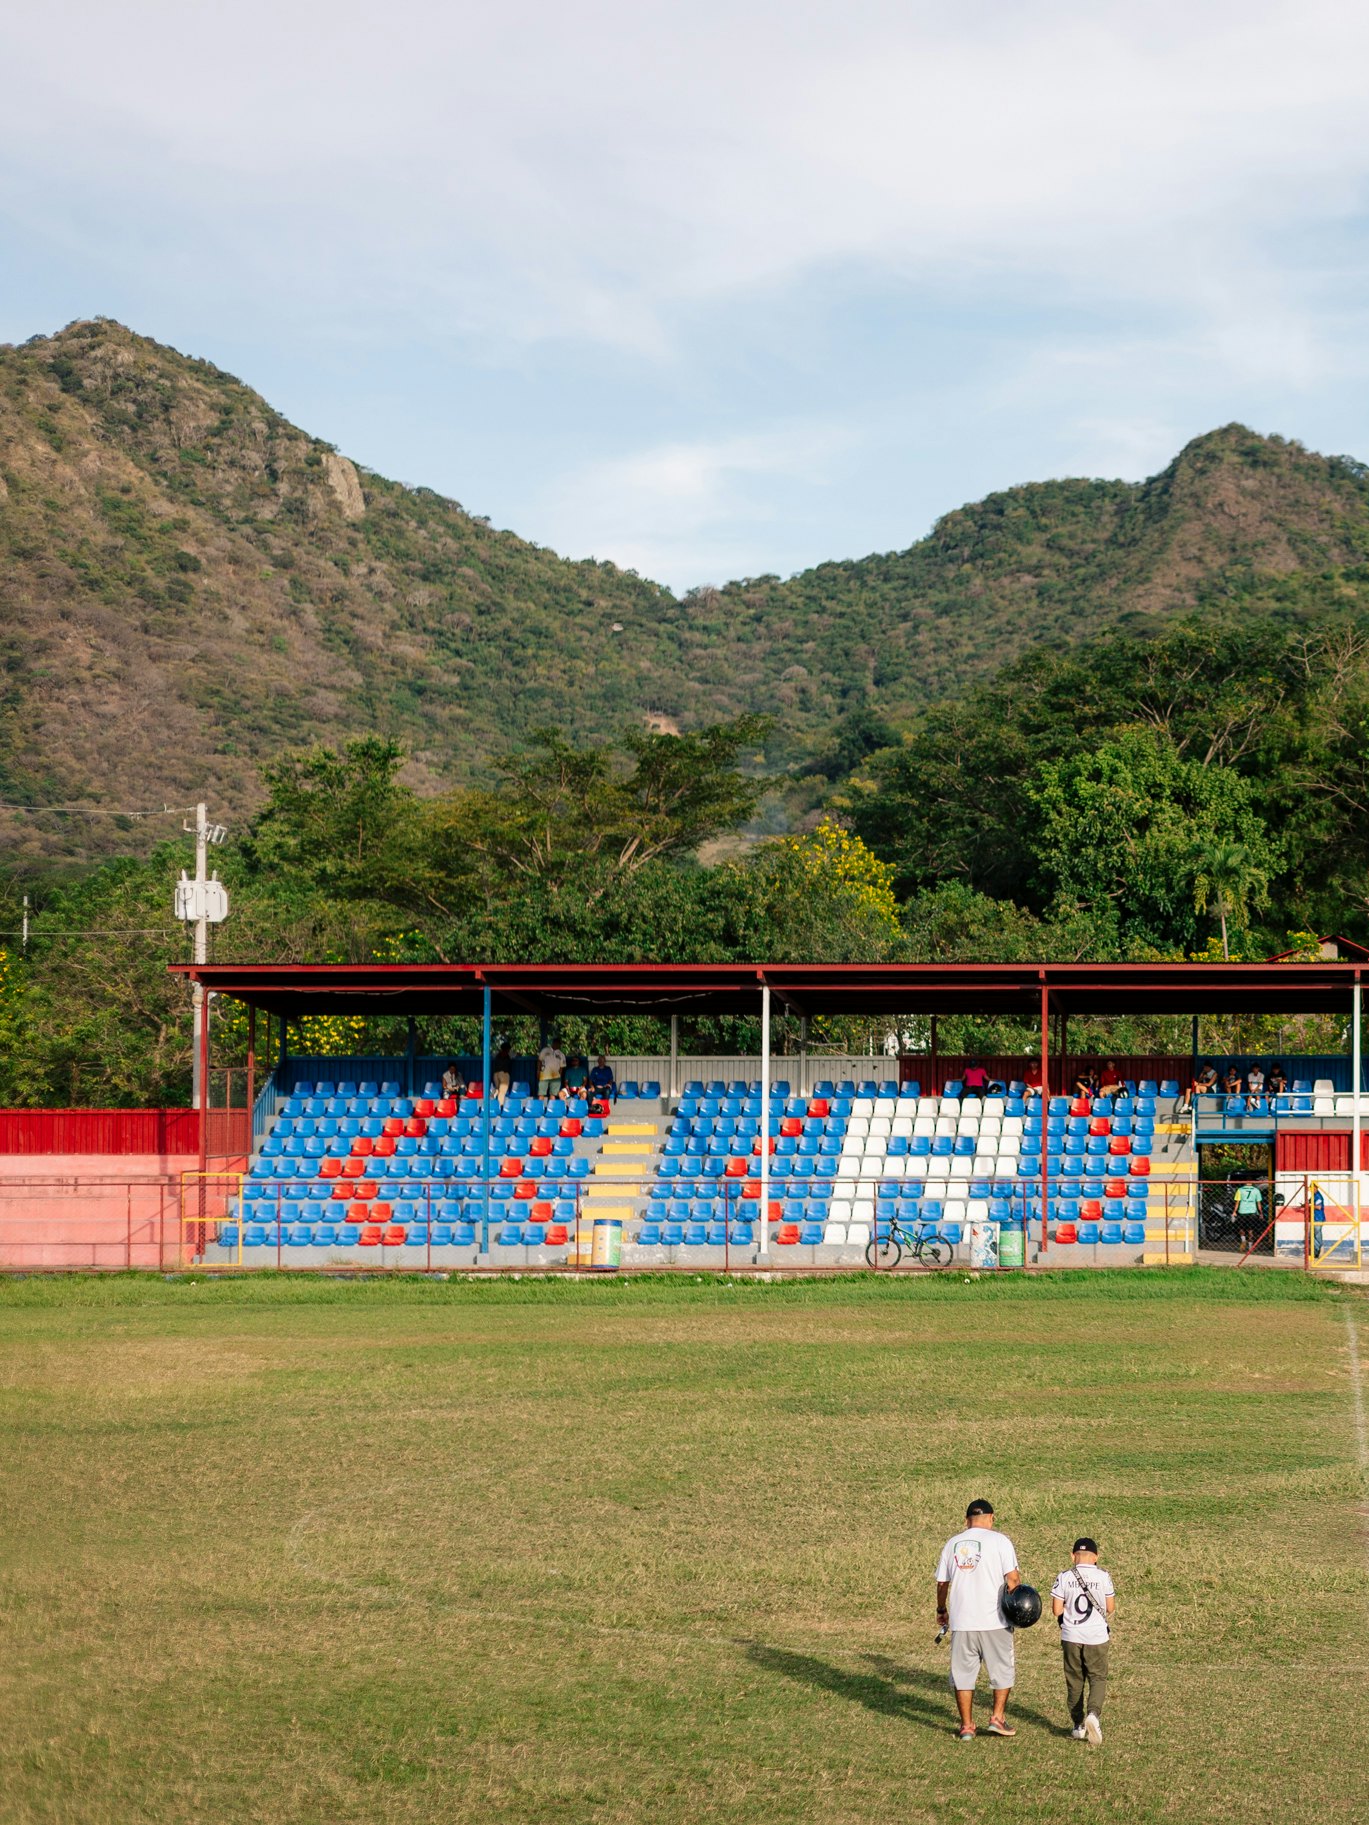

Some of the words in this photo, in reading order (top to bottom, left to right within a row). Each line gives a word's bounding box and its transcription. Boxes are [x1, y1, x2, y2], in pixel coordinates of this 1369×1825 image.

[824, 1098, 1023, 1244] R
[1246, 1190, 1252, 1200] 7
[1068, 1581, 1101, 1591] MBPPE
[1074, 1594, 1094, 1625] 9
